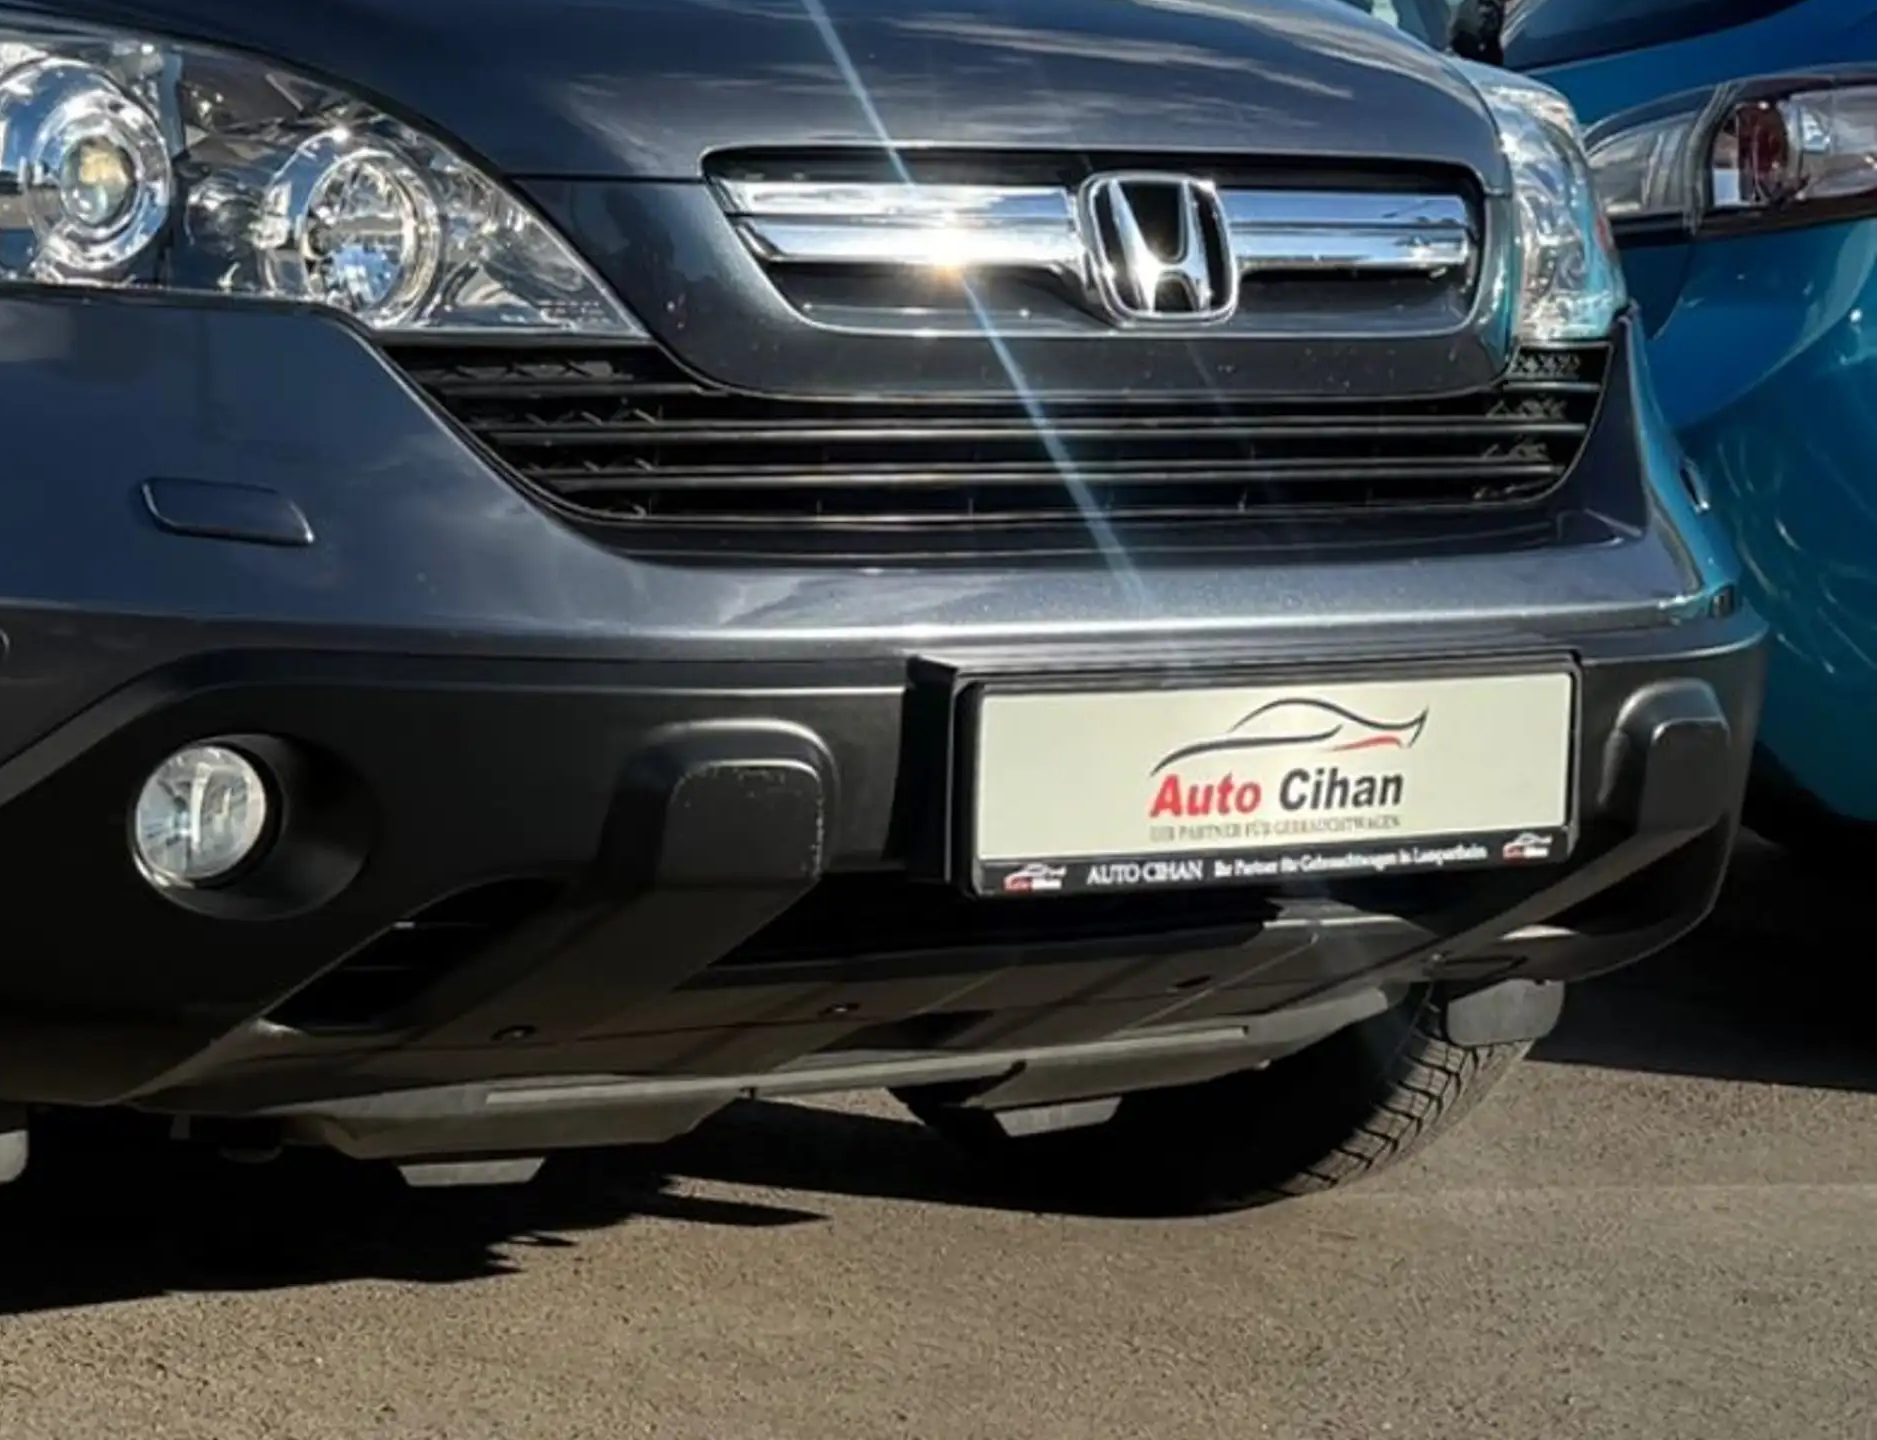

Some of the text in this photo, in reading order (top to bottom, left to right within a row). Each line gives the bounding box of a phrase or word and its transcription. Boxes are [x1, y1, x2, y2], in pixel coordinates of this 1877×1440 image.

[1149, 767, 1404, 818] Auto Cihan
[1087, 863, 1140, 885] AUTO
[1142, 859, 1203, 881] CIHAN
